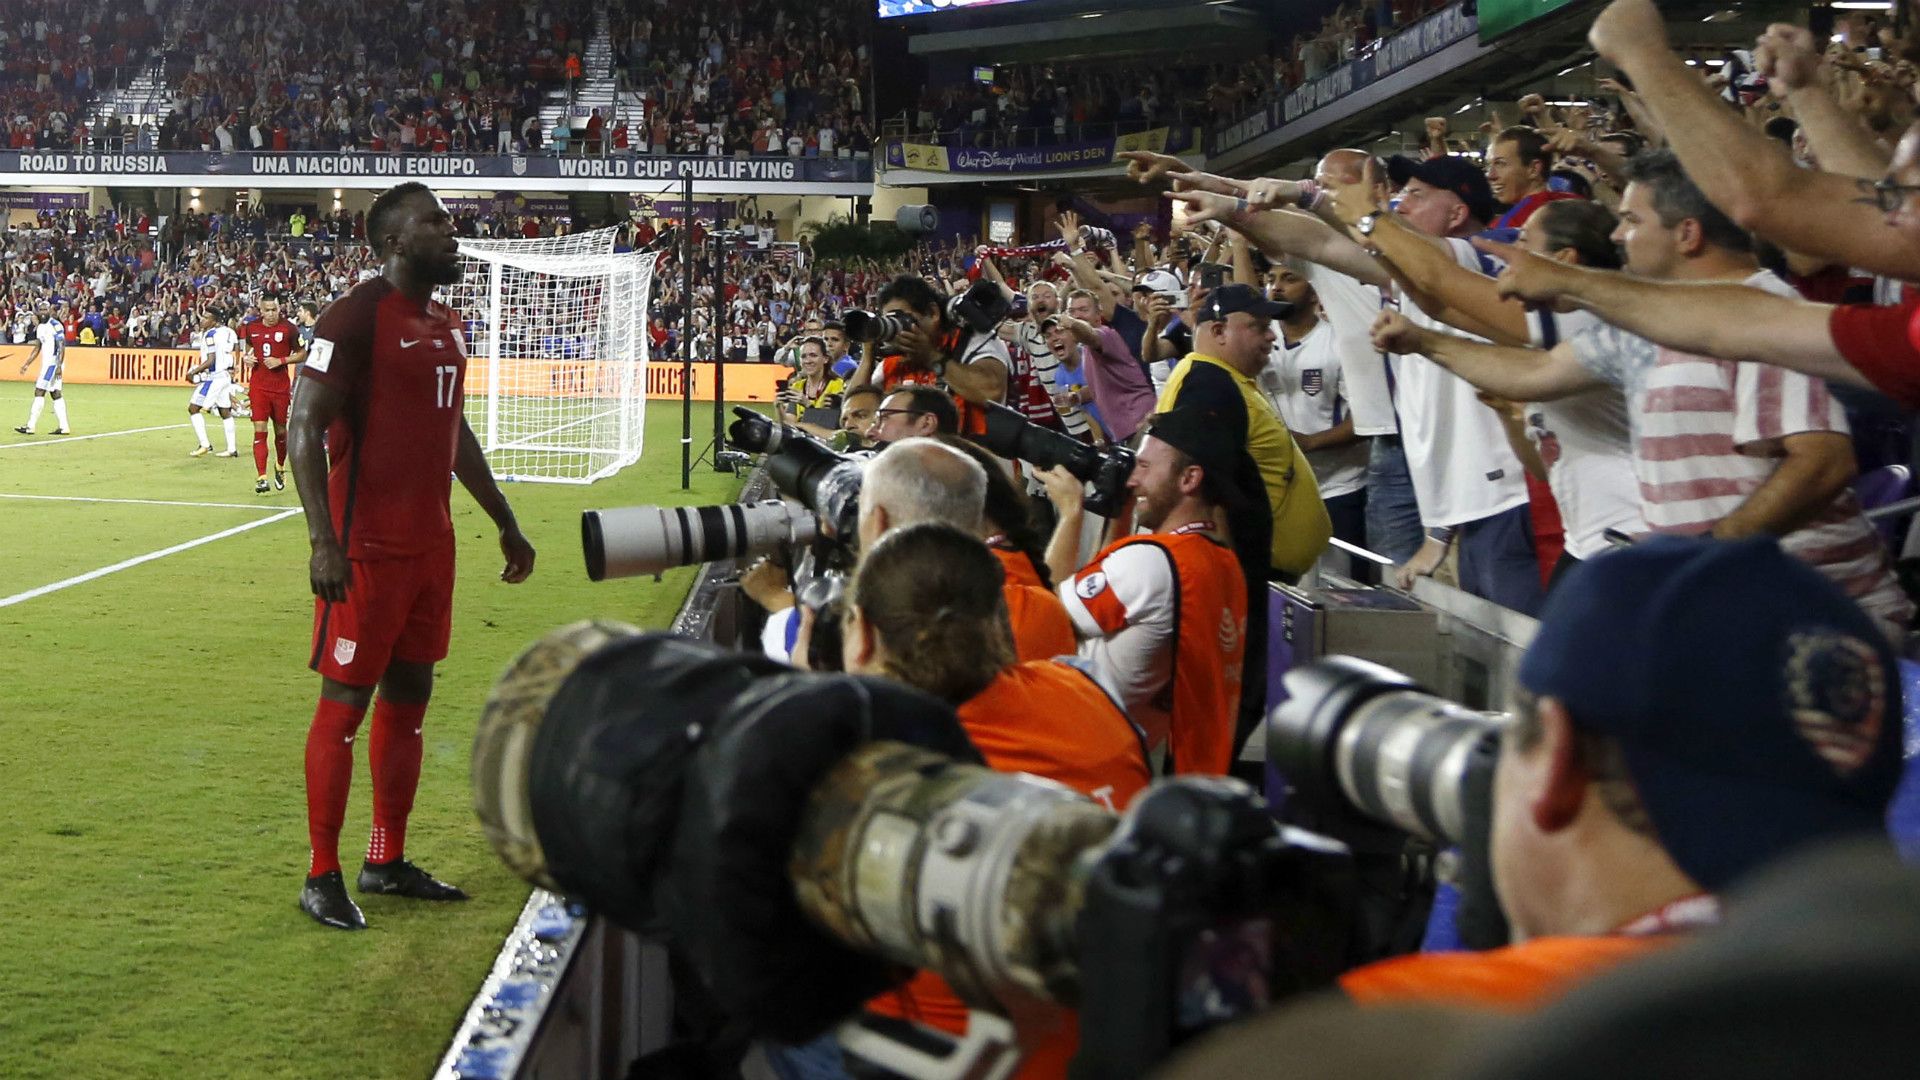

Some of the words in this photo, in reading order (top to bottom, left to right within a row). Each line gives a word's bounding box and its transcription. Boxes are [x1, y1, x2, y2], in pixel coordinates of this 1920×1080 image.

[20, 155, 67, 171] ROAD
[73, 155, 95, 172] TO
[101, 156, 167, 172] RUSSIA
[1017, 153, 1042, 164] World
[1045, 150, 1080, 163] LION'S
[1084, 147, 1105, 160] DEN
[252, 156, 289, 173] UNA
[296, 156, 369, 174] NACIÓN.
[375, 157, 401, 174] UN
[406, 158, 479, 175] EQUIPO.
[559, 159, 627, 177] WORLD
[633, 160, 671, 177] CUP
[678, 160, 794, 179] QUALIFYING
[263, 343, 271, 356] 9
[436, 366, 457, 408] 17
[337, 639, 355, 651] USA
